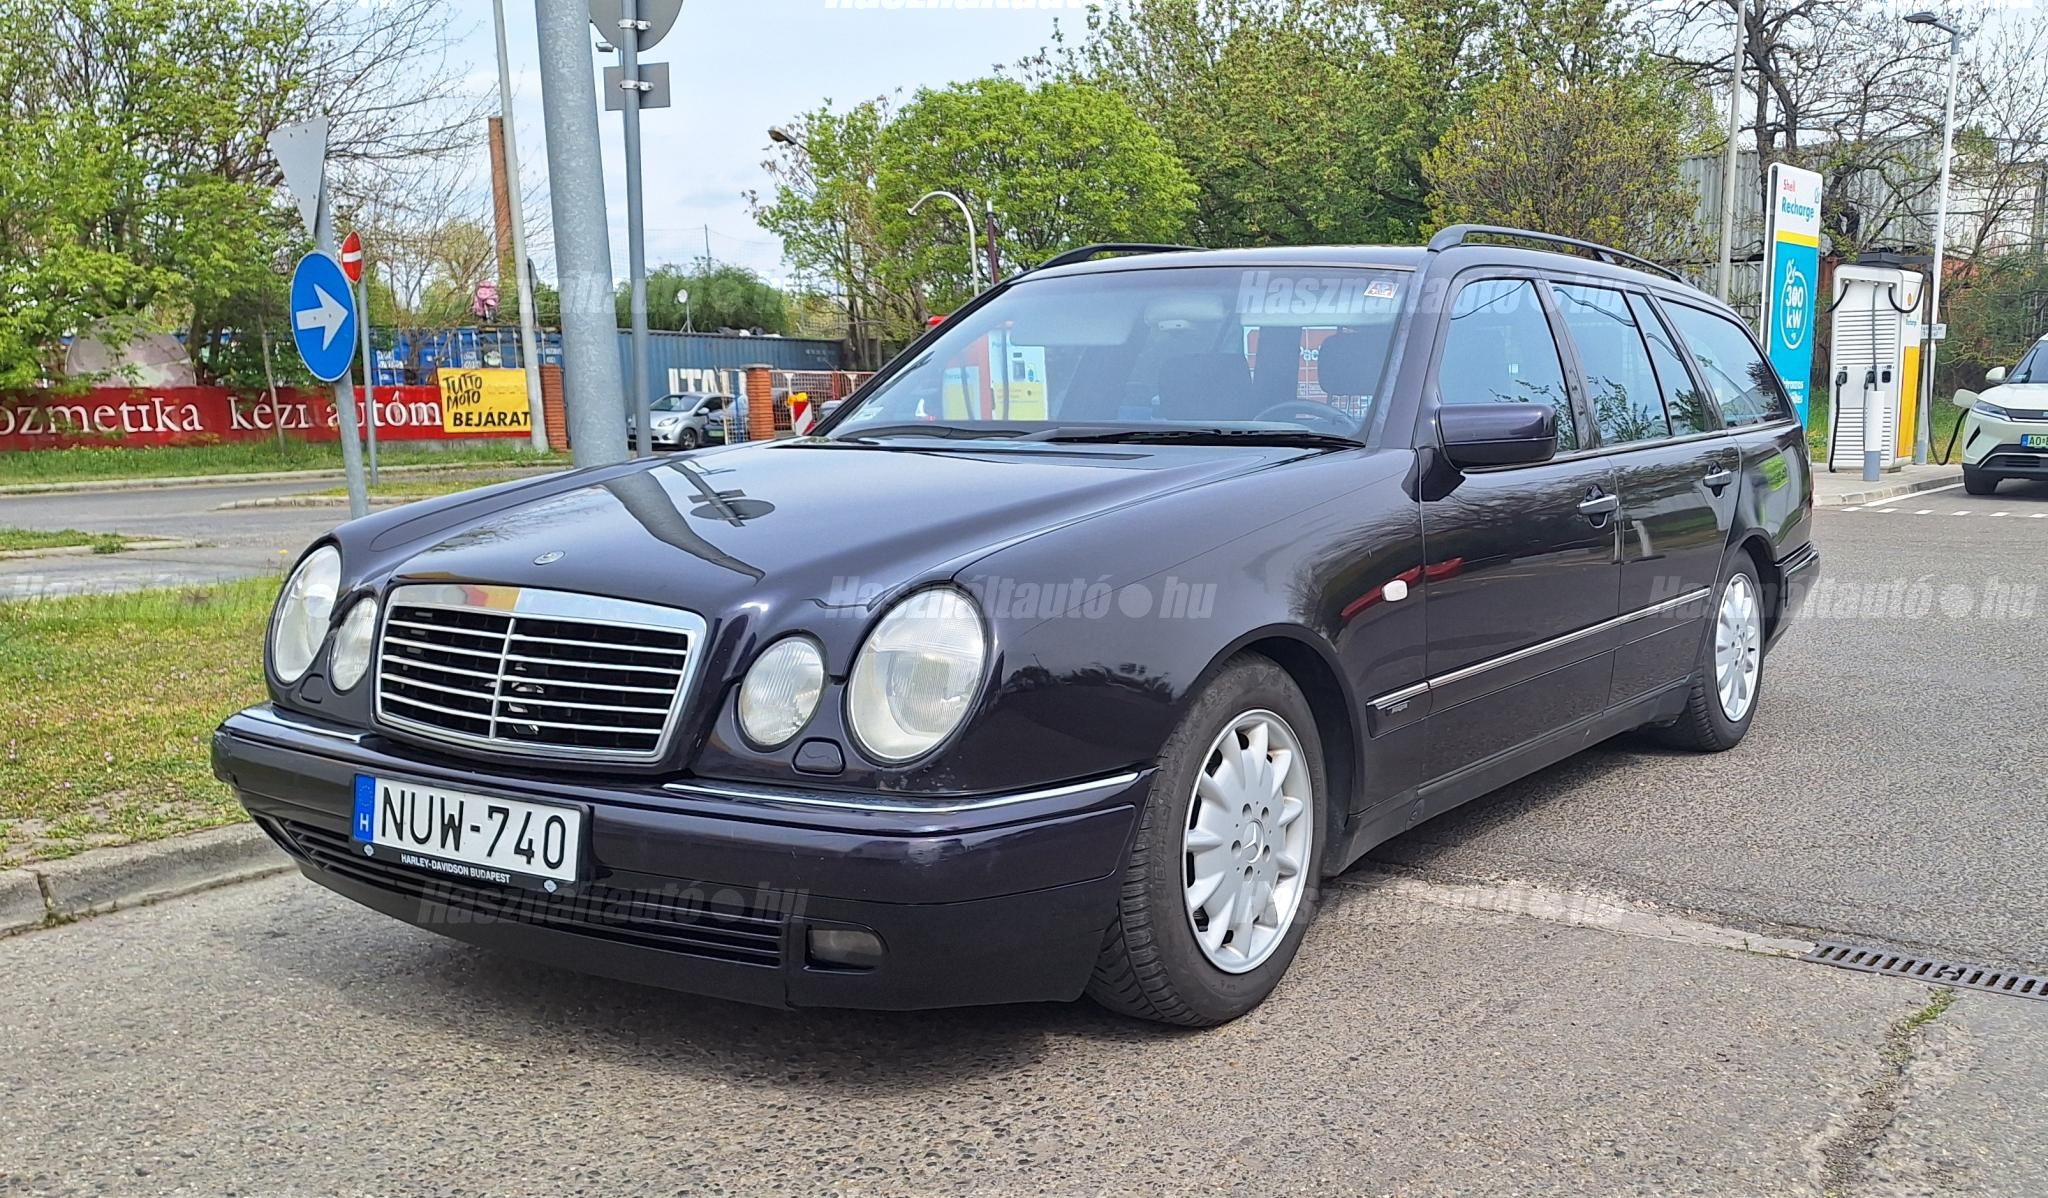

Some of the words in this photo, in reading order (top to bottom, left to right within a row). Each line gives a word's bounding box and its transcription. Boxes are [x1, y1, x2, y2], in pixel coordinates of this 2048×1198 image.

[1783, 179, 1796, 193] Shell
[1781, 197, 1814, 221] Recharge
[1785, 308, 1803, 329] kW
[442, 372, 483, 395] TUTTO
[446, 389, 482, 413] MOTO
[452, 406, 531, 427] BEJÁRAT
[359, 813, 369, 832] H
[381, 786, 566, 870] NUW-740
[401, 853, 469, 876] HARLEY-DAVIDSON
[470, 867, 511, 884] BUDAPEST
